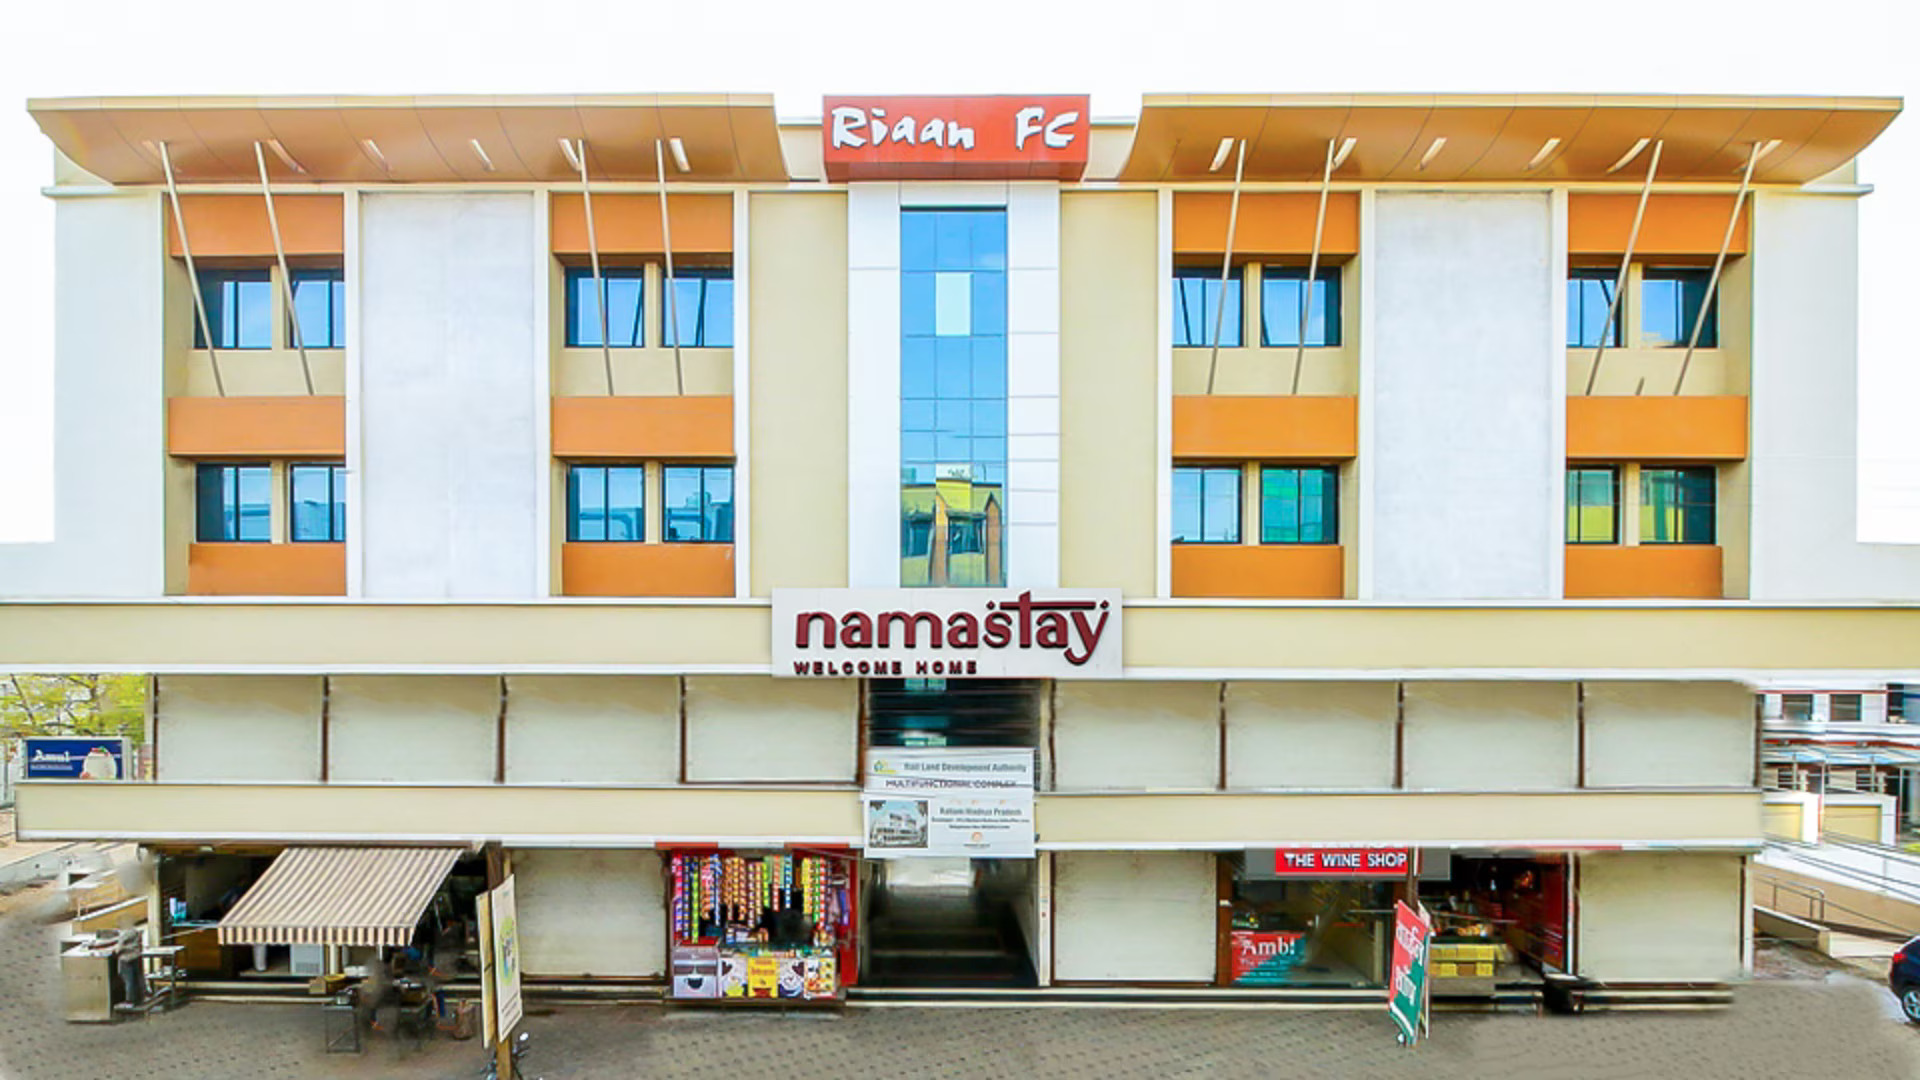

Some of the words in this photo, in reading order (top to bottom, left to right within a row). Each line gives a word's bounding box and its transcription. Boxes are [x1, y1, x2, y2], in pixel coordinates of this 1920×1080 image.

[832, 107, 975, 149] Riaan
[1015, 106, 1079, 150] FC
[796, 591, 1109, 665] namastay
[794, 661, 902, 675] WELCOME
[916, 661, 977, 675] HOME
[942, 762, 990, 773] Development
[992, 762, 1026, 773] Authority
[1284, 853, 1315, 867] THE
[1321, 853, 1361, 867] WINE
[1367, 853, 1407, 867] SHOP
